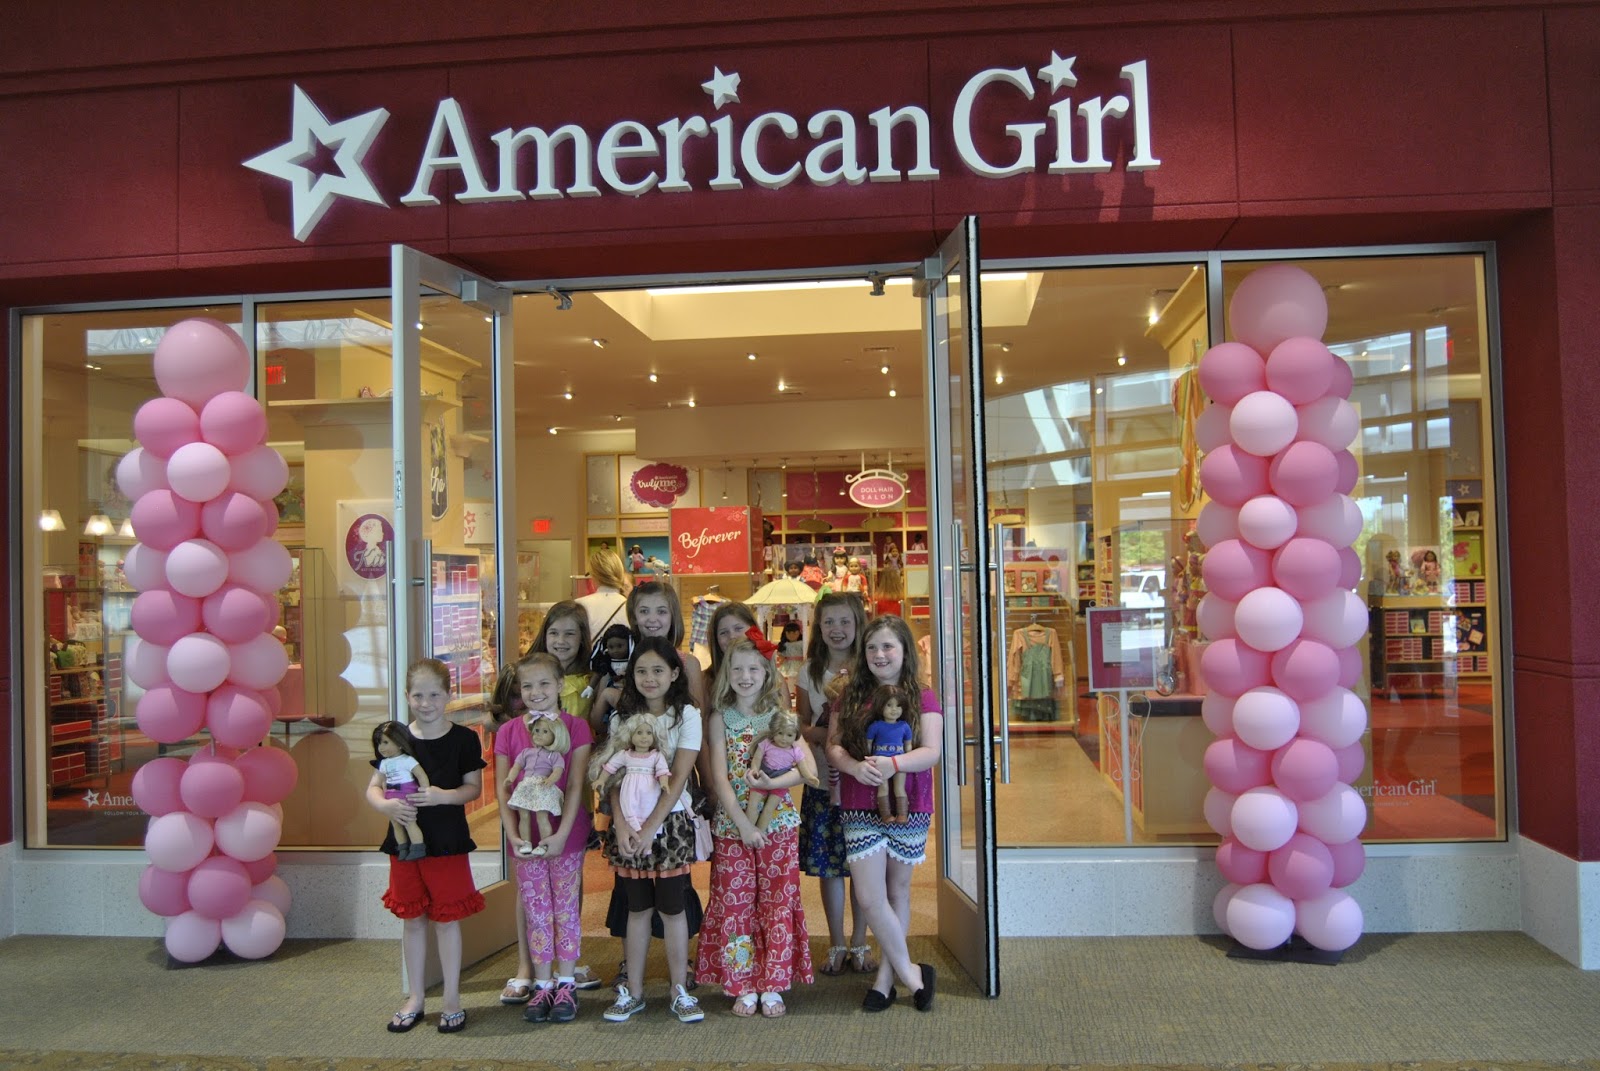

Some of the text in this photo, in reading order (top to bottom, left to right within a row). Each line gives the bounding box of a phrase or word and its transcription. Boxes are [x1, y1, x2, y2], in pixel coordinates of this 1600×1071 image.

[400, 49, 1162, 206] American Girl
[678, 527, 741, 559] Beforever
[1407, 779, 1437, 796] Girl
